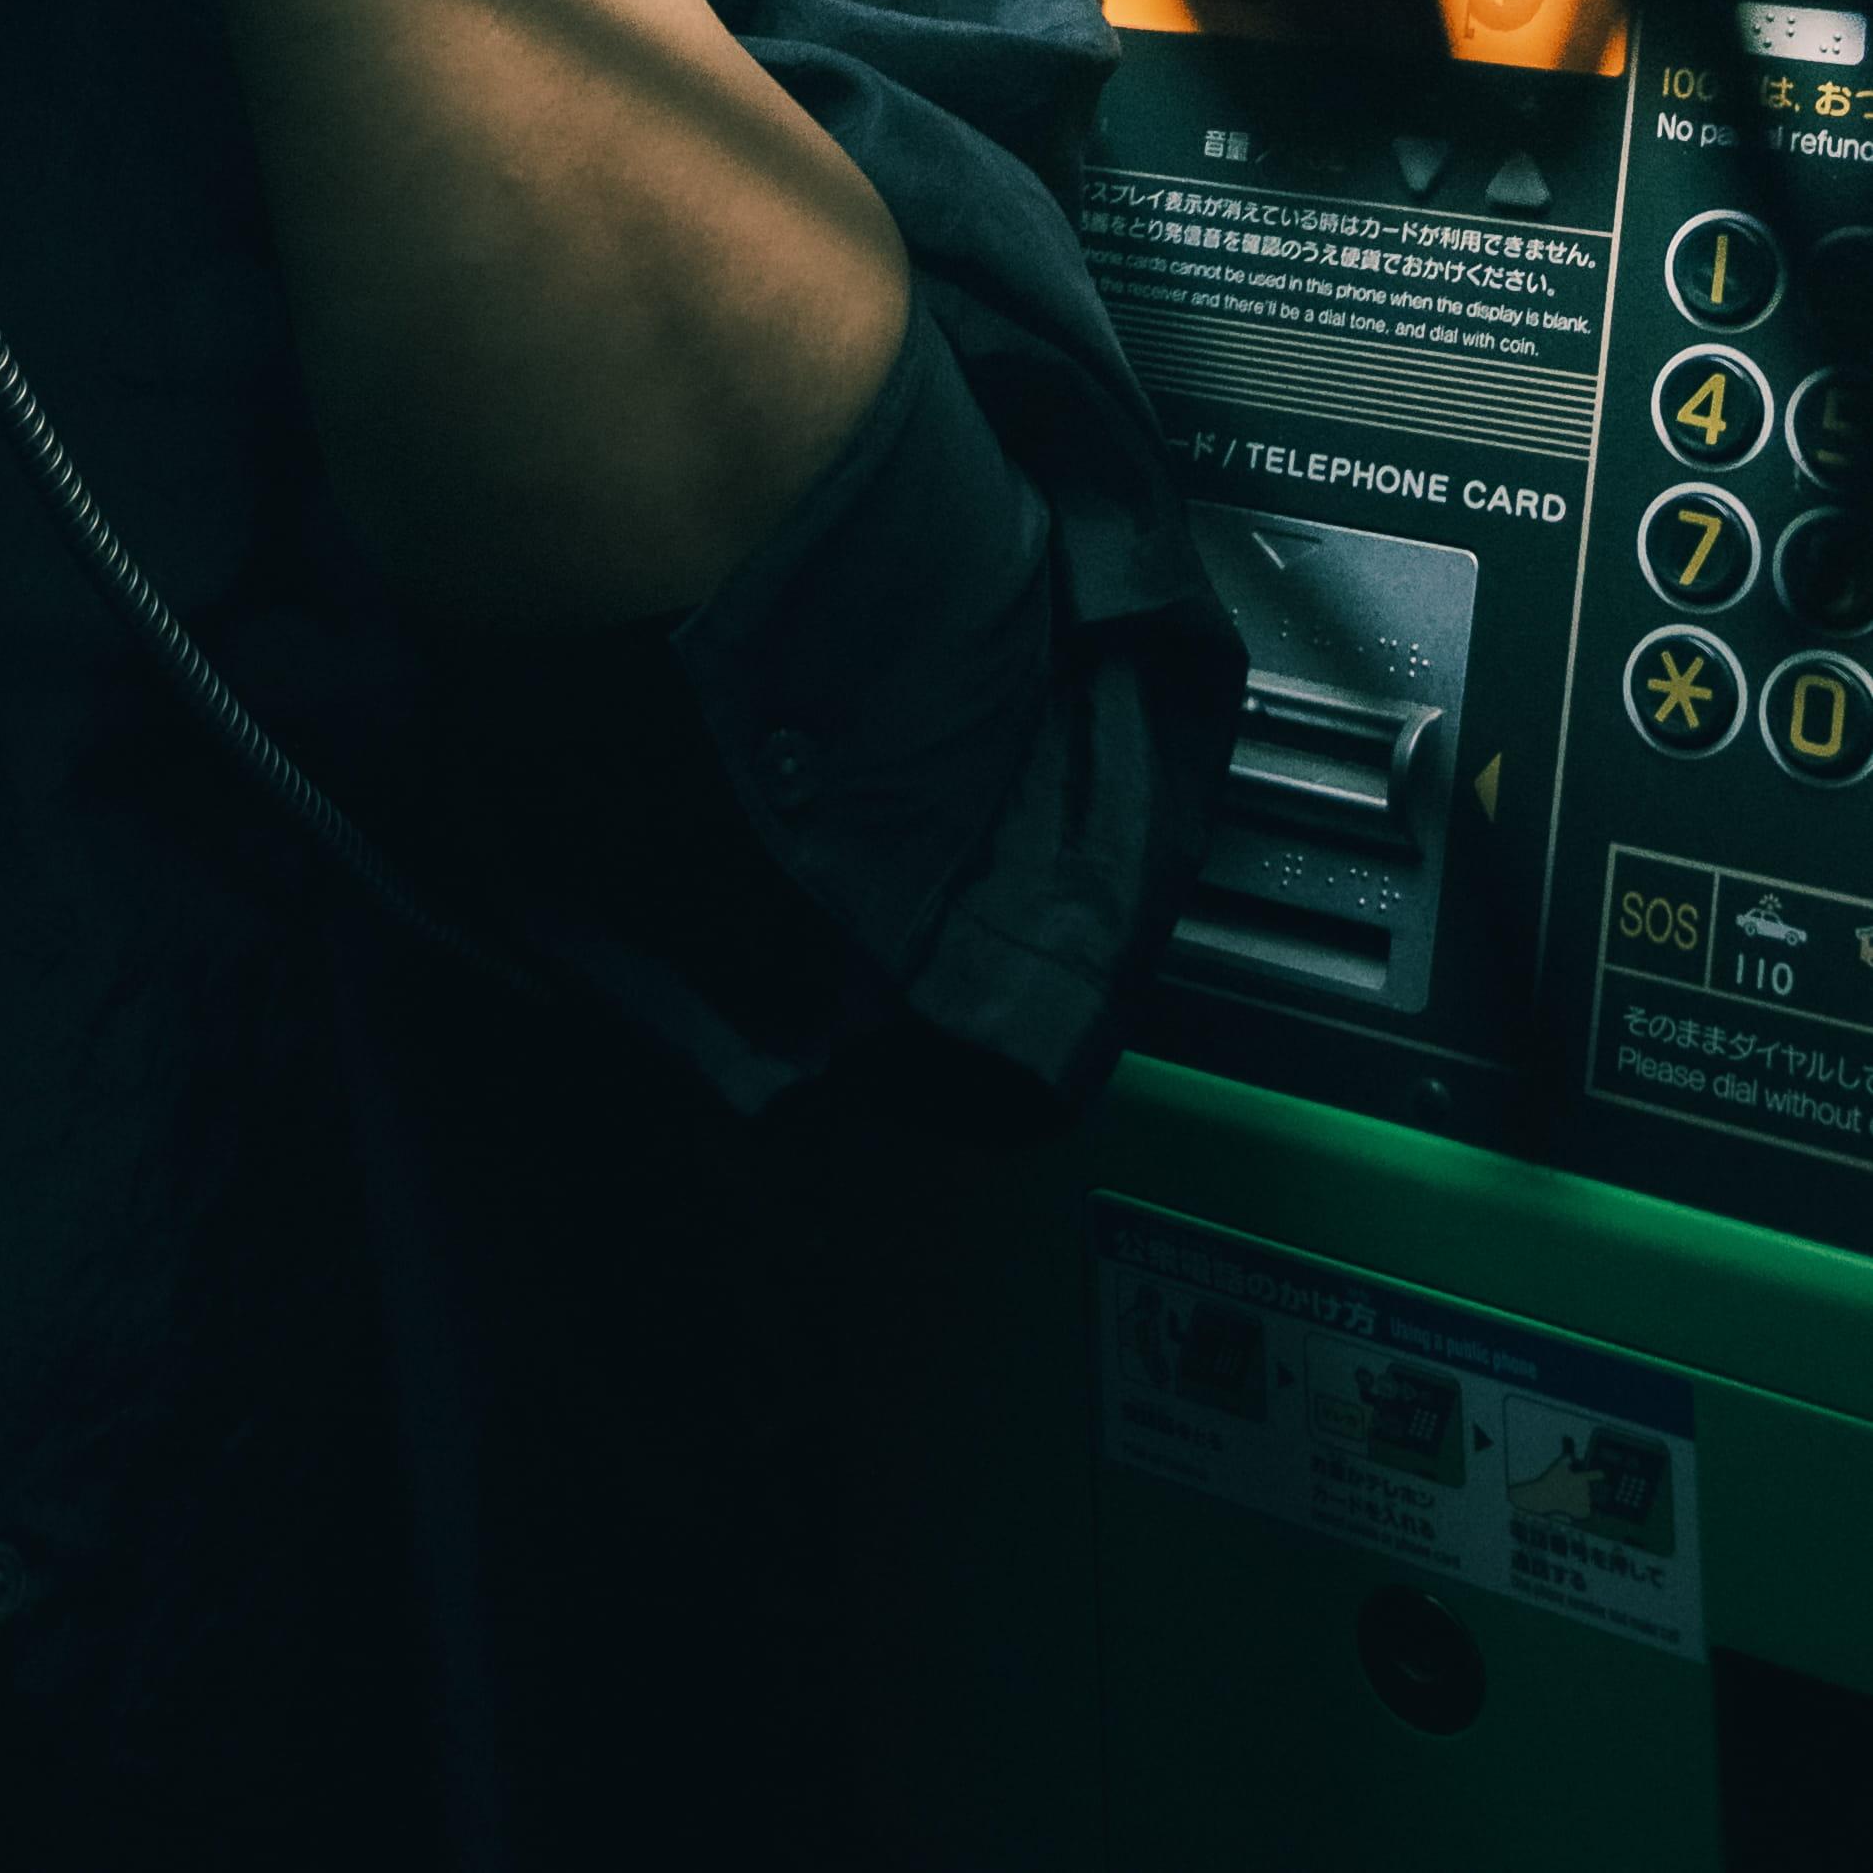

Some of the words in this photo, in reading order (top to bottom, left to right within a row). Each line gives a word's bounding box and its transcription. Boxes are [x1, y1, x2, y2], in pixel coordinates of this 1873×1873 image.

[1203, 128, 1250, 163] 音量
[1655, 109, 1695, 145] No
[1169, 258, 1223, 282] cannot
[1224, 264, 1246, 285] be
[1247, 269, 1287, 292] used
[1288, 274, 1304, 292] in
[1305, 276, 1334, 299] this
[1335, 282, 1388, 307] phone
[1390, 289, 1434, 311] when
[1436, 295, 1464, 317] the
[1466, 298, 1524, 328] display
[1526, 308, 1540, 327] is
[1542, 309, 1594, 336] blank.
[1708, 231, 1730, 305] 1
[1190, 289, 1222, 310] and
[1280, 302, 1302, 323] be
[1303, 307, 1315, 324] a
[1317, 307, 1347, 330] dial
[1394, 319, 1427, 341] and
[1429, 323, 1459, 345] dial
[1461, 330, 1496, 351] with
[1499, 336, 1541, 359] coin.
[1674, 369, 1730, 447] 4
[1244, 439, 1452, 504] TELEPHONE
[1461, 478, 1569, 524] CARD
[1675, 506, 1725, 588] 7
[1787, 671, 1849, 760] 0
[1617, 888, 1701, 952] SOS
[1733, 950, 1797, 999] 110
[1616, 1044, 1707, 1094] Please
[1711, 1071, 1760, 1107] dial
[1764, 1086, 1864, 1136] without
